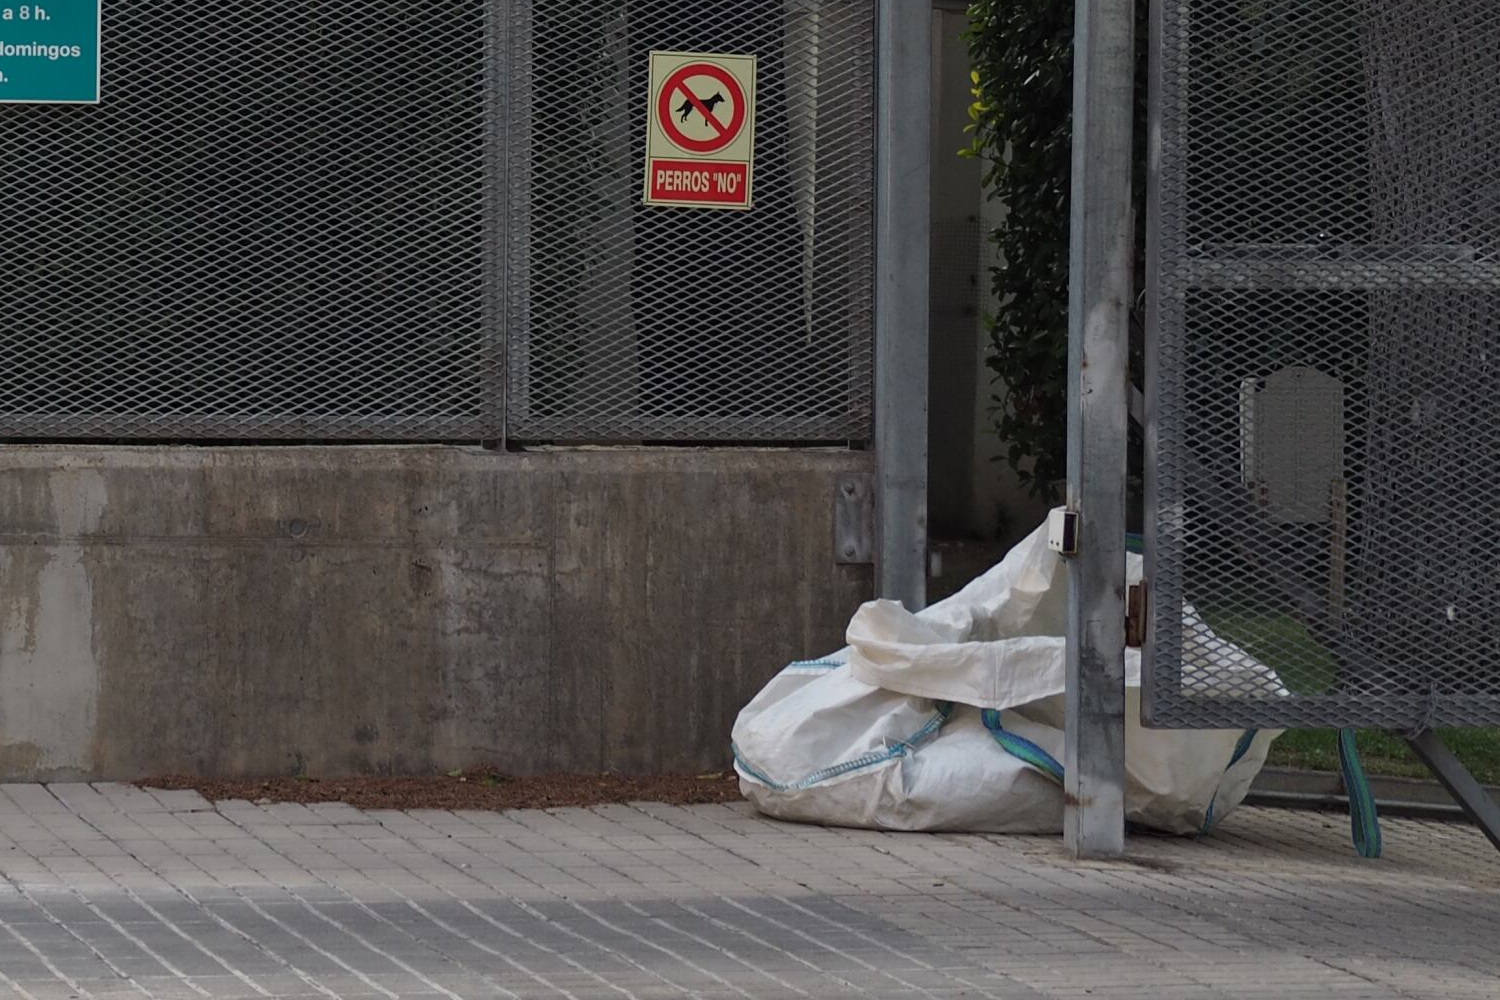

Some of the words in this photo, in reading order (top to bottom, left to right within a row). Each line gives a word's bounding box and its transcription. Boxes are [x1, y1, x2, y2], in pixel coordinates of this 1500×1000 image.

[2, 8, 13, 20] a
[19, 6, 30, 20] 8
[35, 6, 51, 21] h.
[656, 170, 710, 192] PERROS
